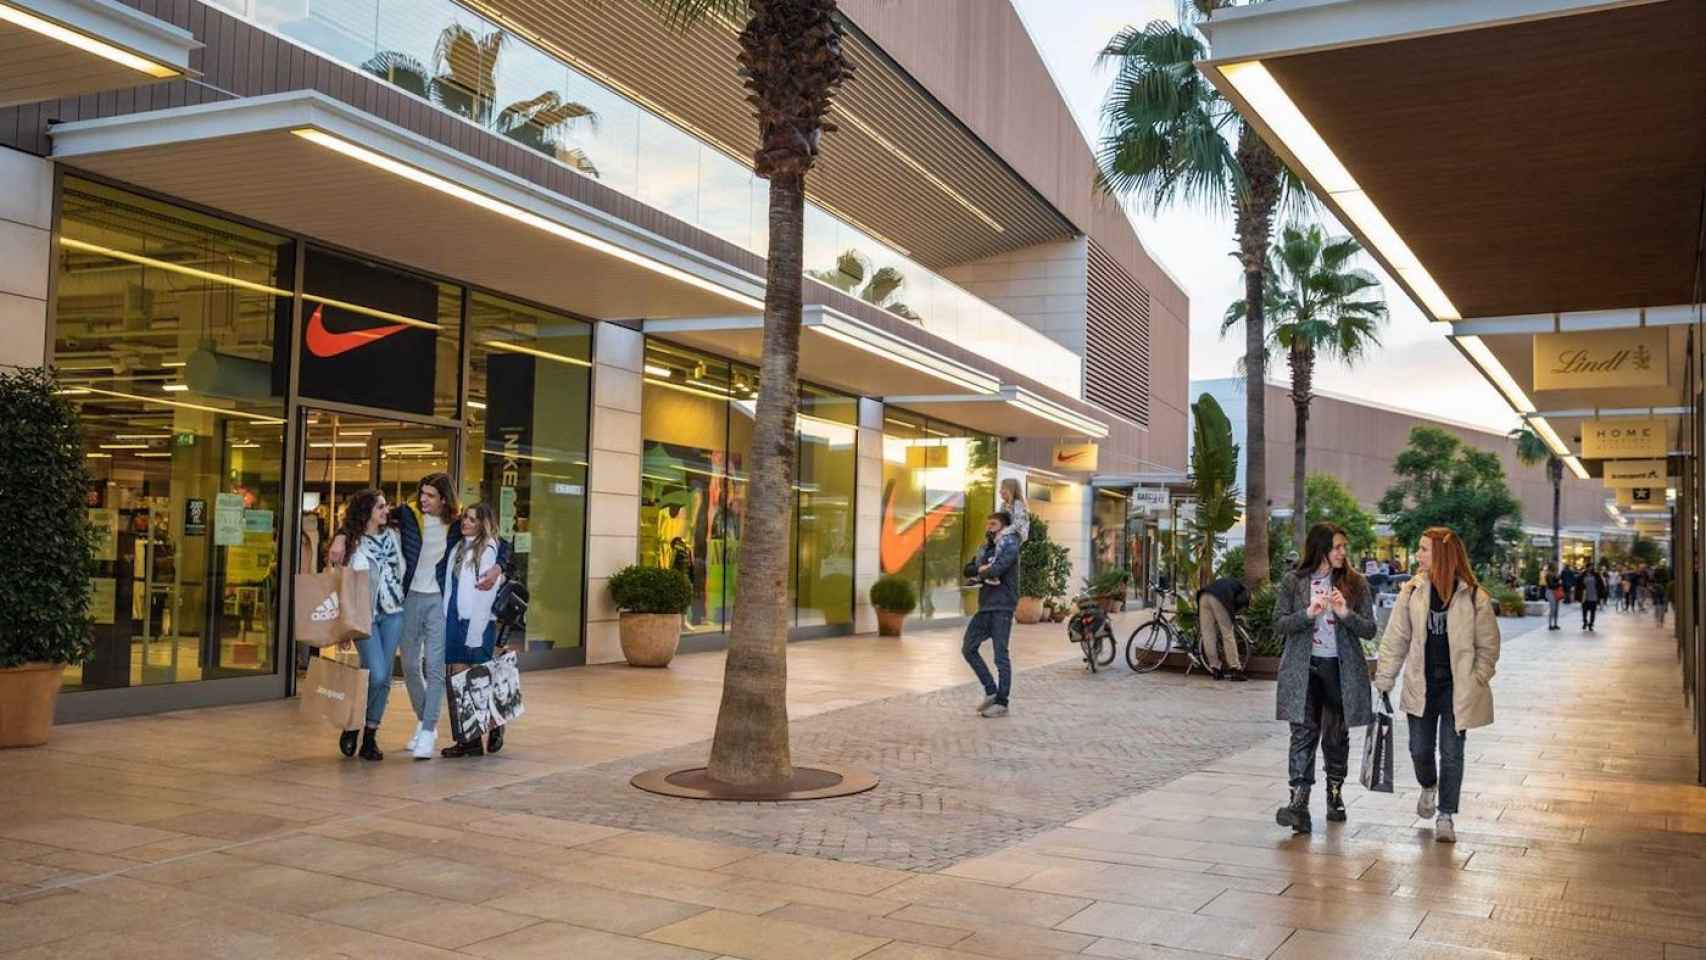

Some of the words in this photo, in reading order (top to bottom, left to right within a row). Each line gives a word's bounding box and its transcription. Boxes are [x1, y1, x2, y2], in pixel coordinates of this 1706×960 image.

[1550, 349, 1630, 374] Lindt
[1596, 428, 1651, 438] HOME
[503, 434, 519, 487] NIKE
